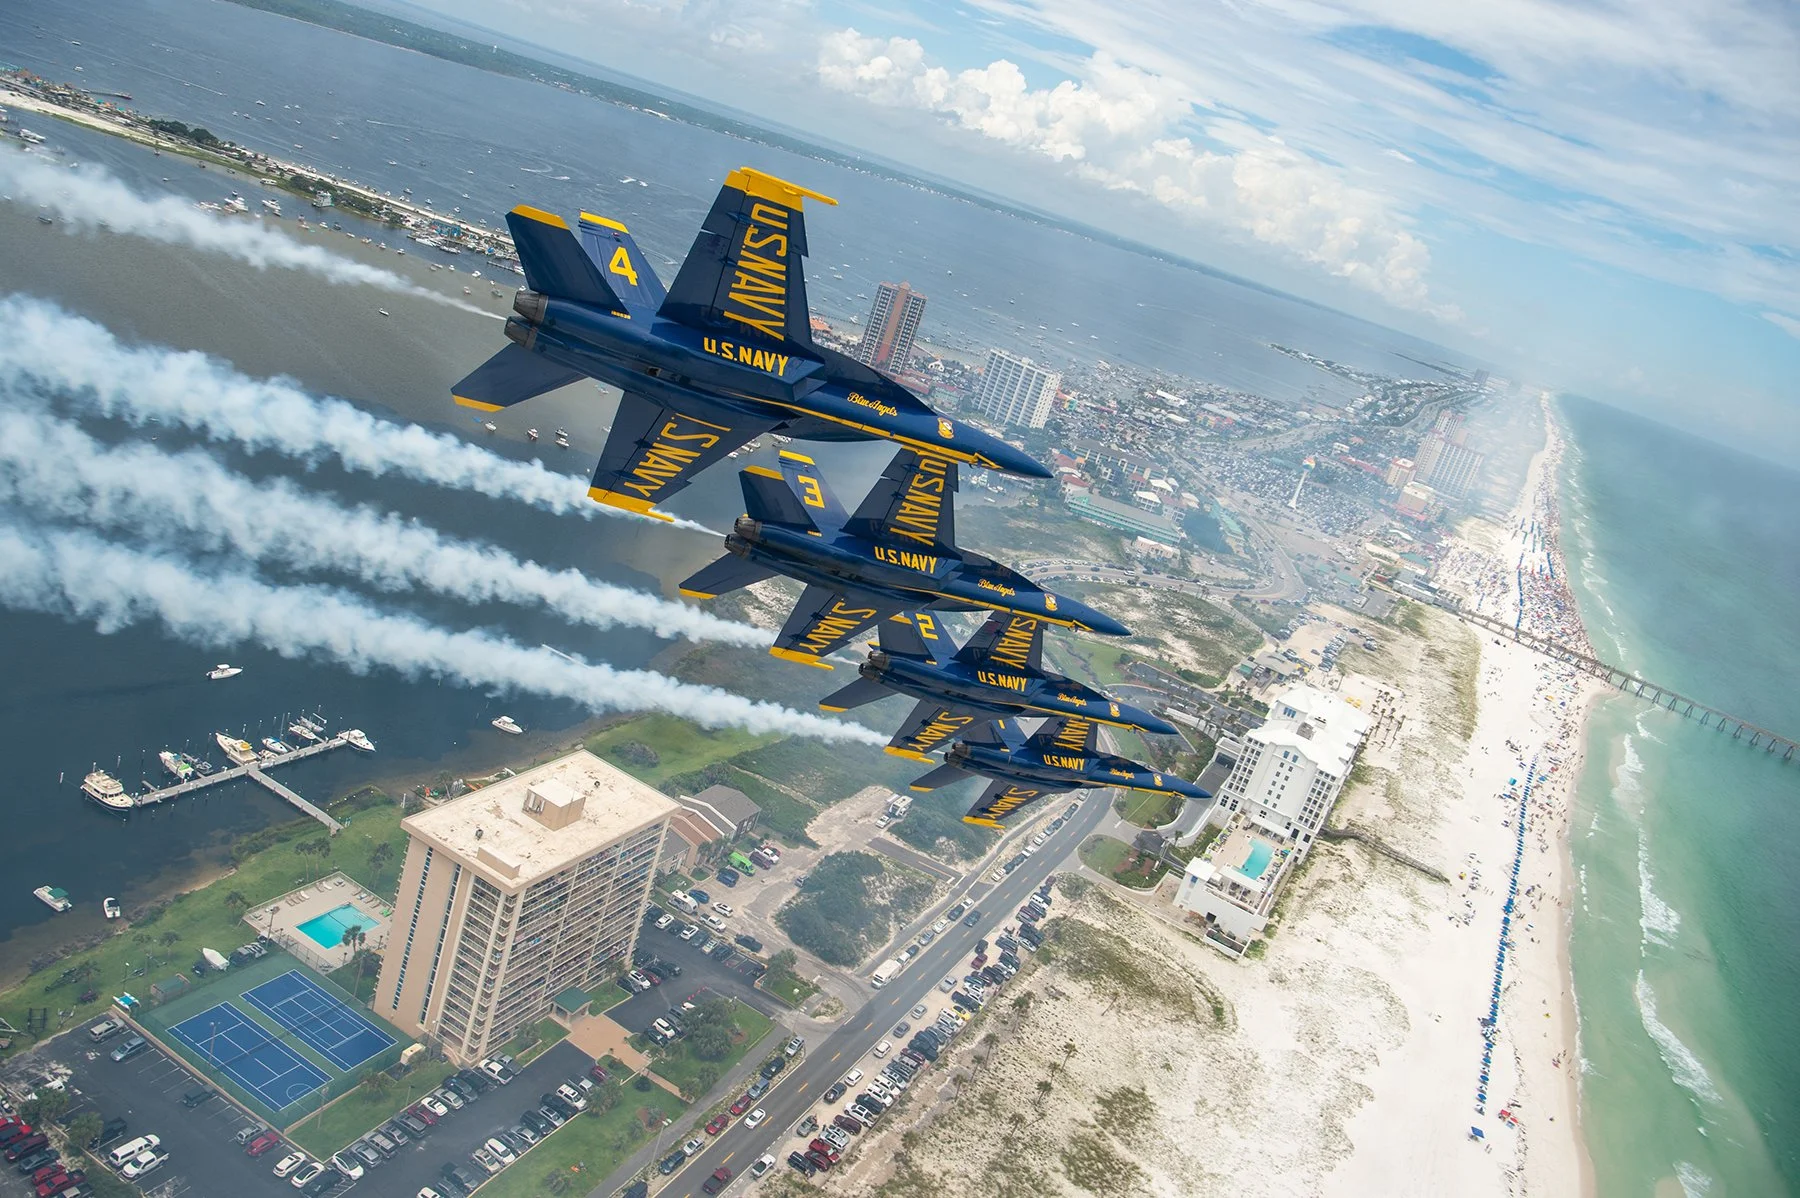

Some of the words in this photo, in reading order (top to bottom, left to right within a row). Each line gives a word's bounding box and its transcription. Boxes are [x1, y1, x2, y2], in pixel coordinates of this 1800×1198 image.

[608, 245, 638, 286] 4
[847, 391, 869, 407] Blue
[868, 399, 898, 417] Angels
[797, 474, 825, 509] 3
[915, 613, 939, 640] 2
